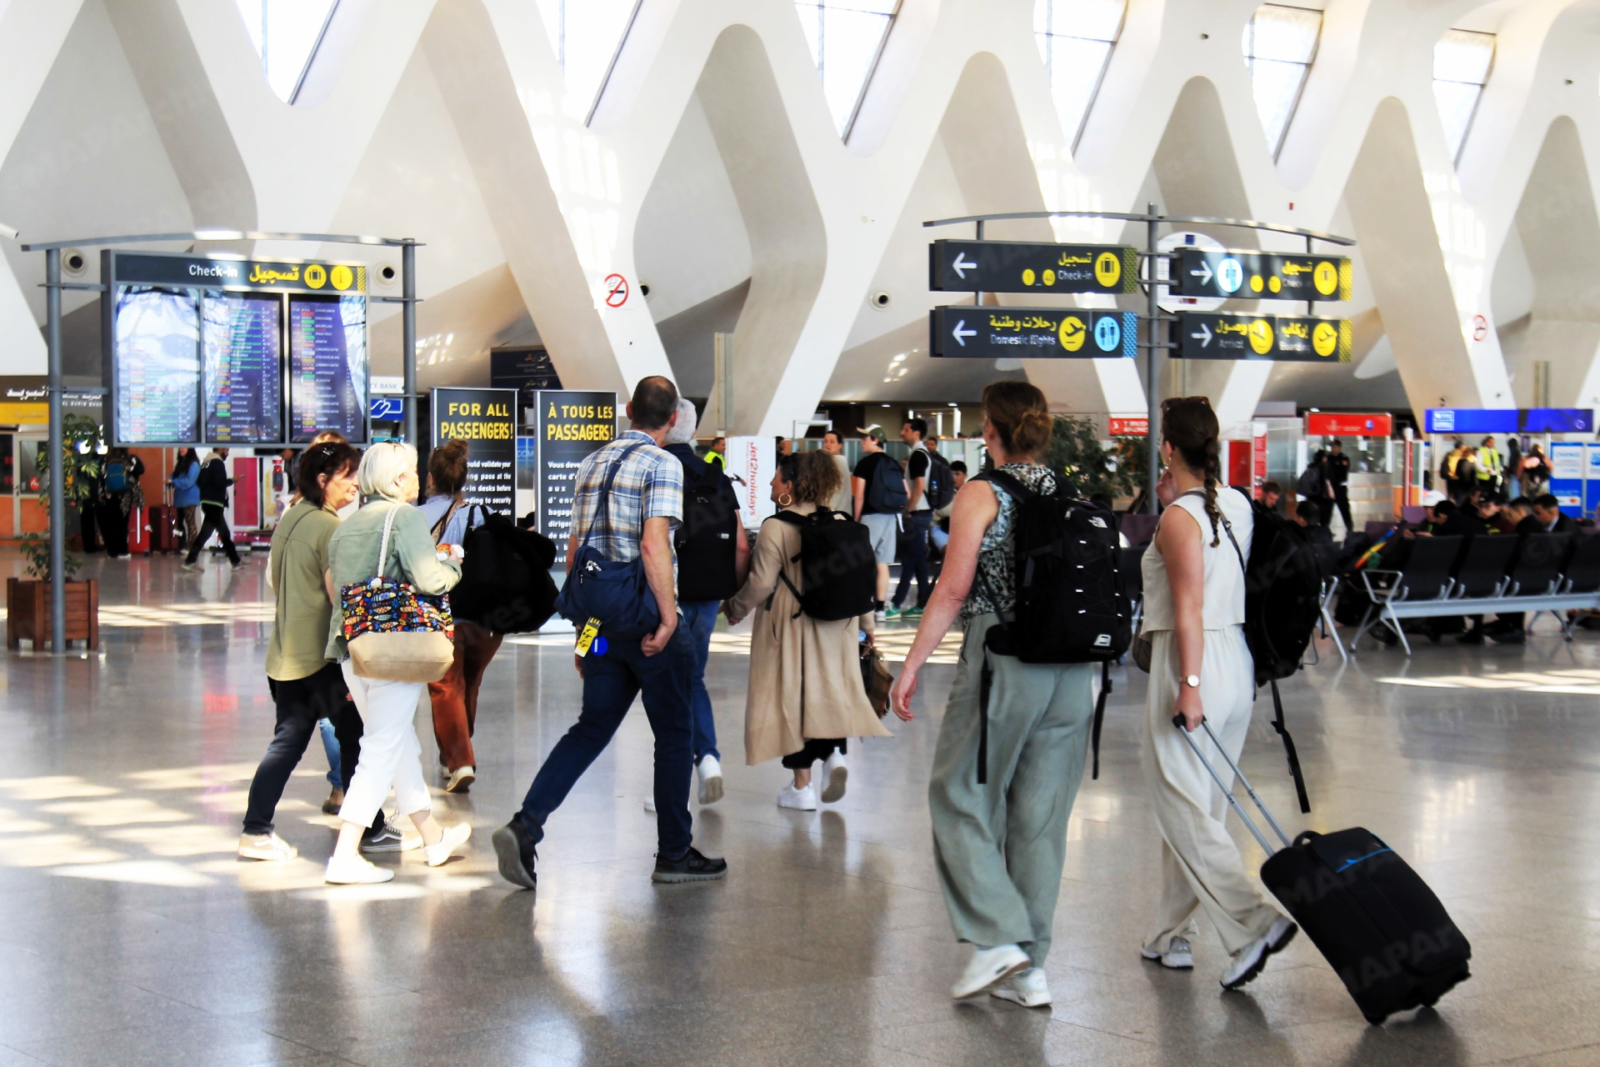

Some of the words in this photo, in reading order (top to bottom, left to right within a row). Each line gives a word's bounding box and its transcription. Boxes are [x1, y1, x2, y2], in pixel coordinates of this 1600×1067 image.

[1058, 251, 1093, 268] تسجيل
[189, 264, 237, 278] Check-in
[248, 264, 301, 284] تسجيل
[1058, 270, 1093, 280] Check-in
[990, 315, 1021, 332] وطنية
[1022, 316, 1057, 332] رحلات
[990, 334, 1028, 344] Domestic
[448, 402, 481, 416] FOR
[486, 404, 509, 417] ALL
[547, 402, 557, 418] À
[561, 405, 595, 419] TOUS
[598, 406, 613, 419] LES
[441, 422, 514, 439] PASSENGERS!
[547, 424, 614, 441] PASSAGERS!
[748, 442, 759, 516] Jet2holidays
[492, 497, 511, 505] security
